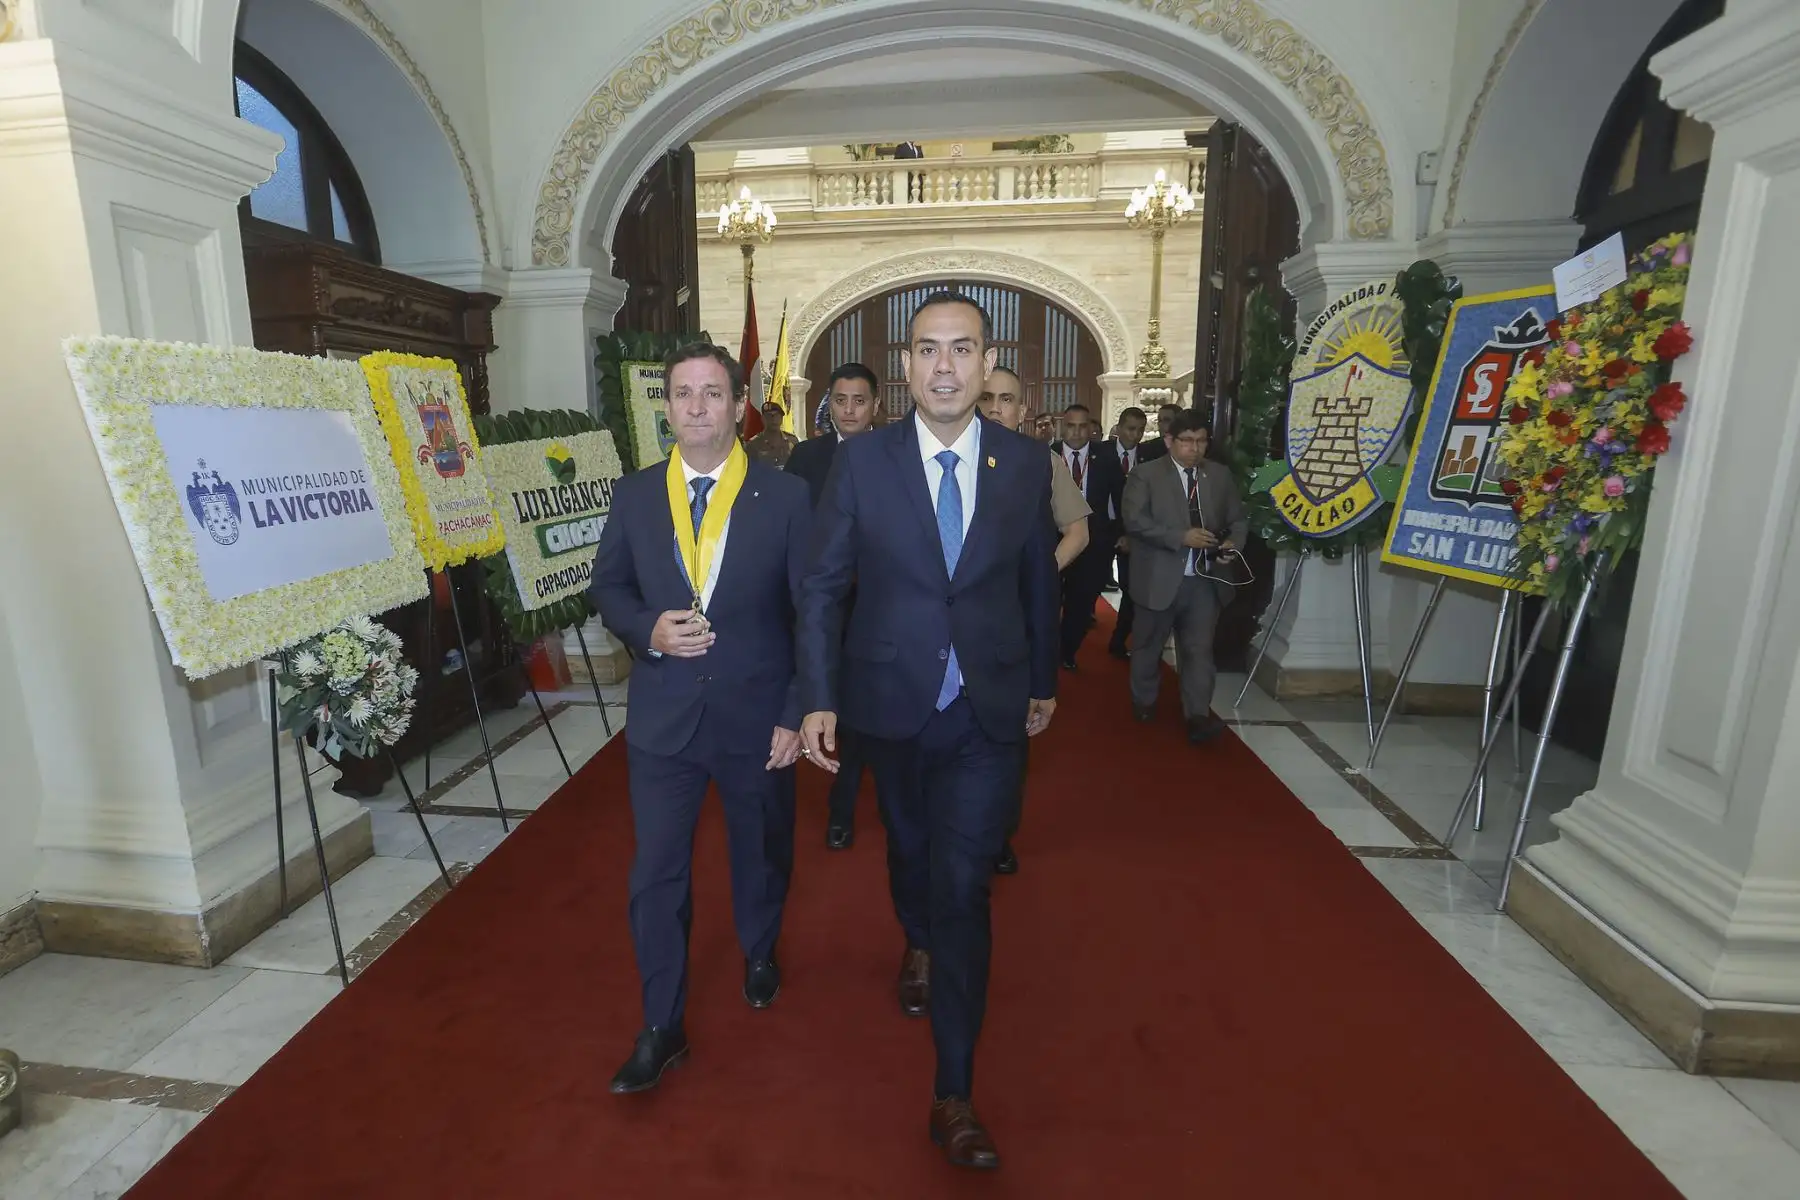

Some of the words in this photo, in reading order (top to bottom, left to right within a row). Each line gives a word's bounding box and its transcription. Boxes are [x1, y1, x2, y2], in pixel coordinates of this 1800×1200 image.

[1298, 283, 1387, 355] MUNICIPALIDAD
[241, 471, 348, 496] MUNICIPALIDAD
[350, 469, 367, 483] DE
[247, 497, 284, 529] LA
[280, 488, 374, 523] VICTORIA
[1282, 492, 1355, 527] CALLAO
[1407, 531, 1455, 561] SAN
[535, 562, 590, 598] CAPACIDAD
